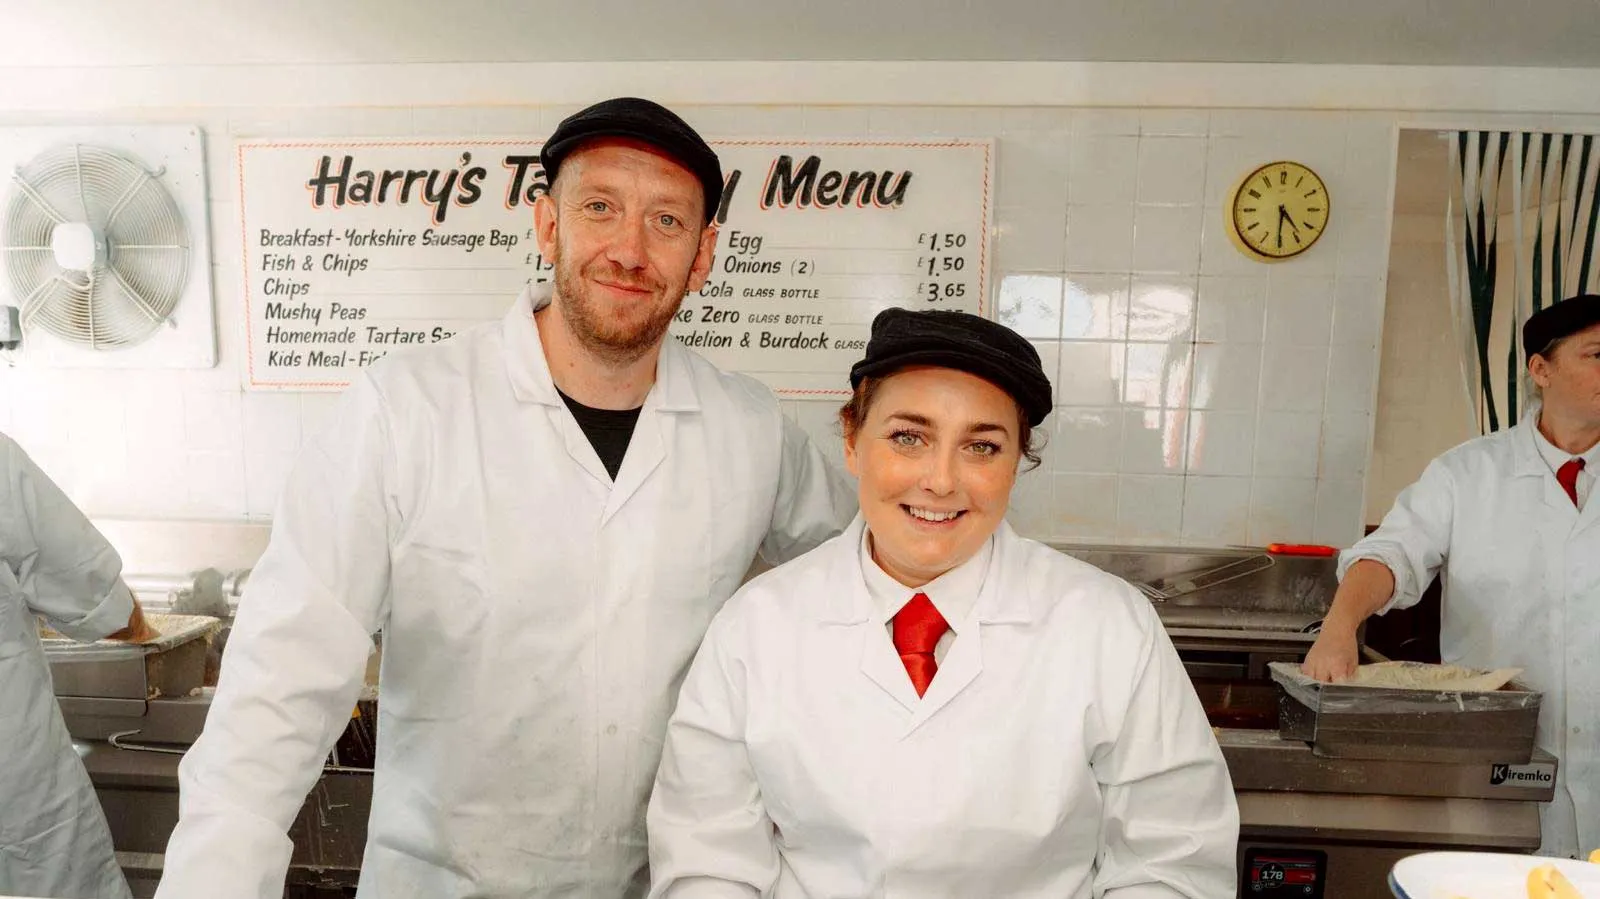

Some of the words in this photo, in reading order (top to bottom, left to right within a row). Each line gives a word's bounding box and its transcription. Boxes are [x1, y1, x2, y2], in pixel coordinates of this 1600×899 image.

[305, 150, 487, 226] Harry's
[760, 154, 913, 210] Menu
[422, 228, 485, 252] Sausage
[490, 229, 518, 252] Bap
[728, 231, 763, 255] Egg
[262, 253, 296, 271] Fish
[302, 255, 314, 271] &
[322, 253, 368, 277] Chips
[724, 255, 781, 274] Onions
[791, 258, 816, 277] (2)
[263, 278, 310, 300] Chips
[700, 280, 733, 298] Cola
[743, 287, 774, 298] GLASS
[781, 288, 819, 299] BOTTLE
[265, 302, 321, 326] Mushy
[330, 302, 367, 320] Peas
[701, 305, 740, 323] Zero
[748, 313, 780, 325] GLASS
[785, 314, 823, 325] BOTTLE
[267, 326, 356, 343] Homemade
[366, 326, 425, 344] Tartare
[740, 332, 751, 348] &
[759, 331, 828, 350] Burdock
[834, 340, 865, 350] GLASS
[268, 350, 302, 367] Kids
[1492, 766, 1551, 782] Kiremko
[1262, 870, 1283, 880] 178
